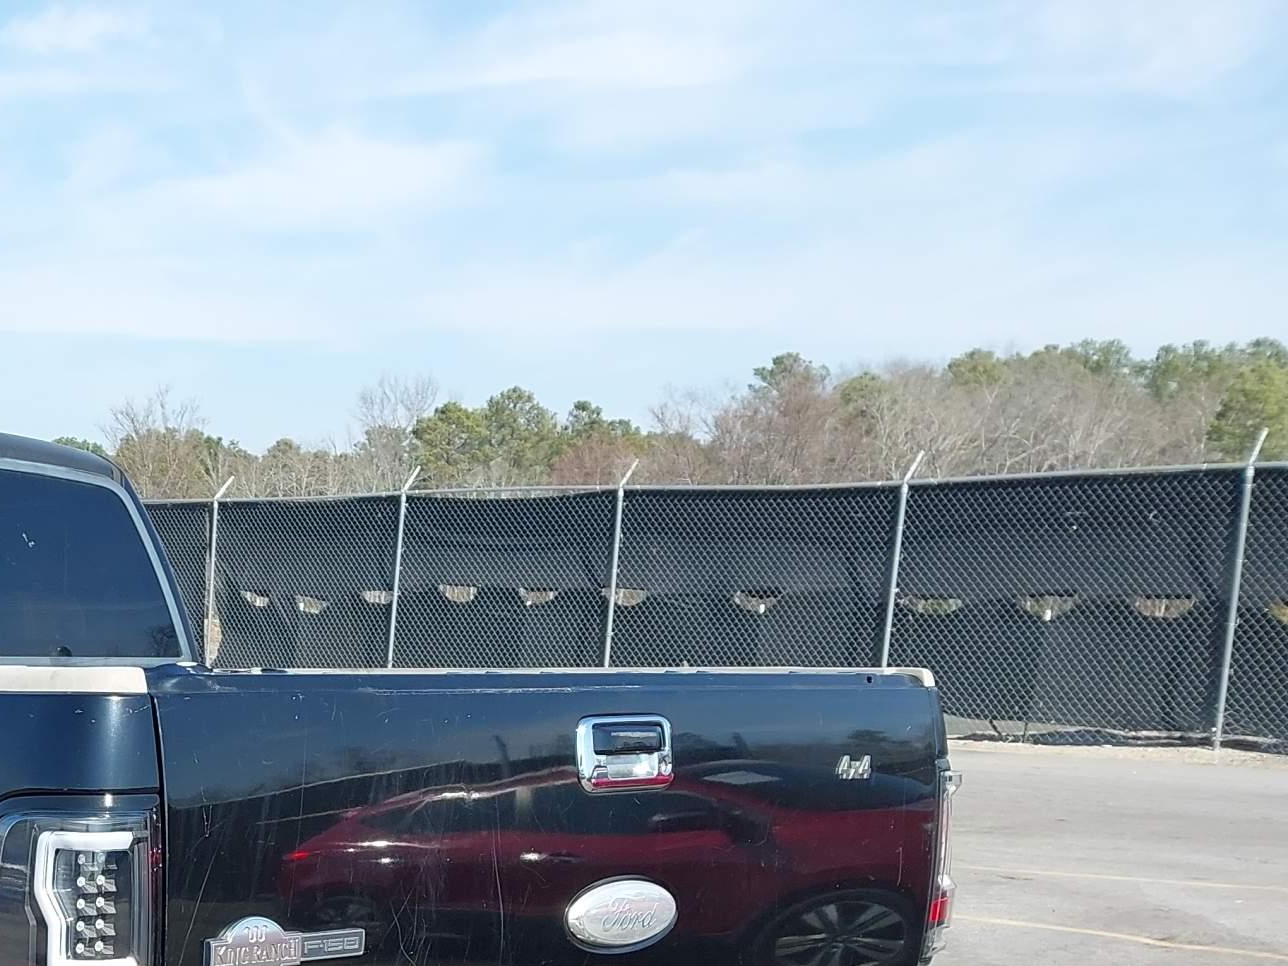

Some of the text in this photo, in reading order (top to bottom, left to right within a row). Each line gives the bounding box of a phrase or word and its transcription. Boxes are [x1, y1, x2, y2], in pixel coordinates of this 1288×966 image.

[600, 897, 660, 932] Ford
[214, 938, 299, 966] KING RANCH
[303, 936, 360, 954] F-150
